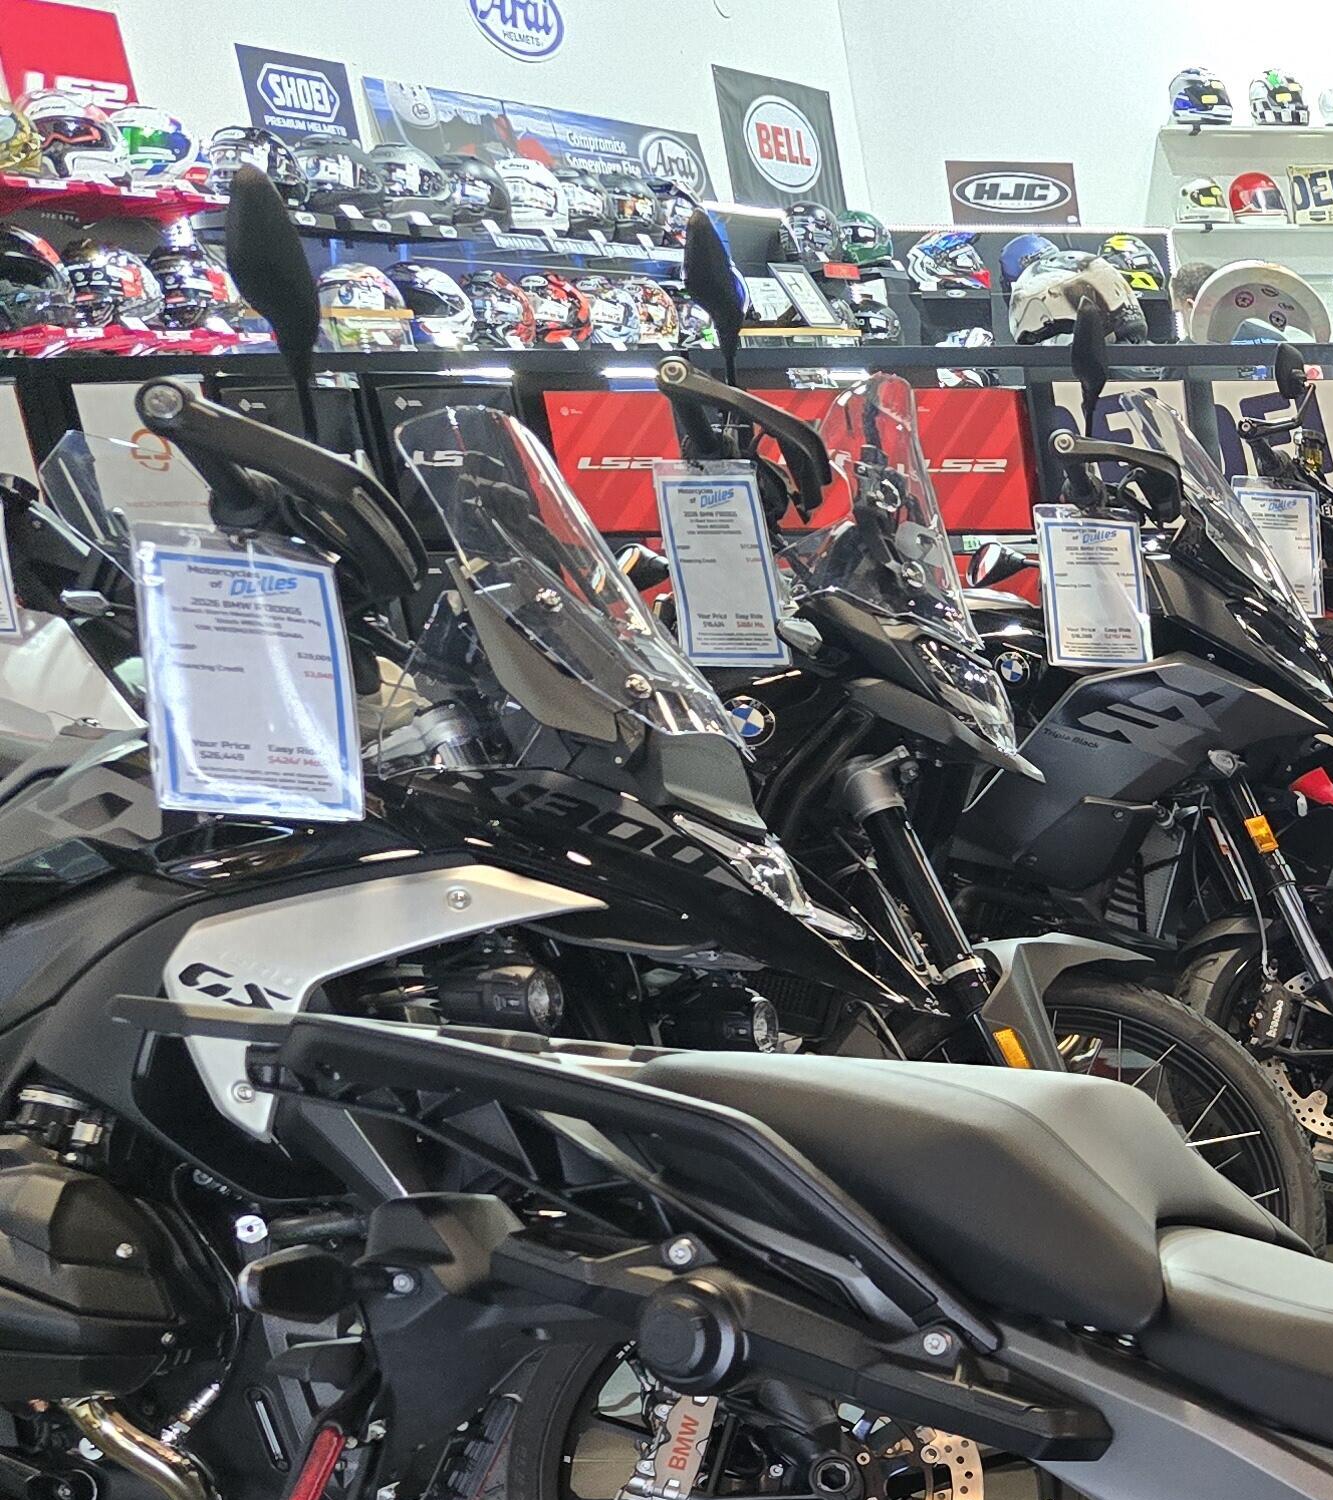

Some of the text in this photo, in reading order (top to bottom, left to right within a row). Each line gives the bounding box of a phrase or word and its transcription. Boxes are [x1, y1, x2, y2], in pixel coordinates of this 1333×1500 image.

[268, 73, 331, 113] SHOEI
[264, 115, 347, 137] PREMIUM HELMETS
[566, 132, 627, 154] Compromise
[755, 120, 812, 167] BELL
[652, 142, 696, 179] Arai
[973, 183, 1050, 200] HJC
[927, 458, 1008, 473] LS2
[700, 488, 734, 509] Dulles
[1082, 530, 1117, 544] Dulles
[187, 564, 261, 579] Motorcycles
[209, 575, 298, 597] of Dulles
[191, 739, 250, 750] Your Price
[1042, 728, 1100, 749] Triple Black
[268, 745, 319, 756] Easy Rid
[1264, 998, 1285, 1040] brembo
[667, 1413, 700, 1472] BMW
